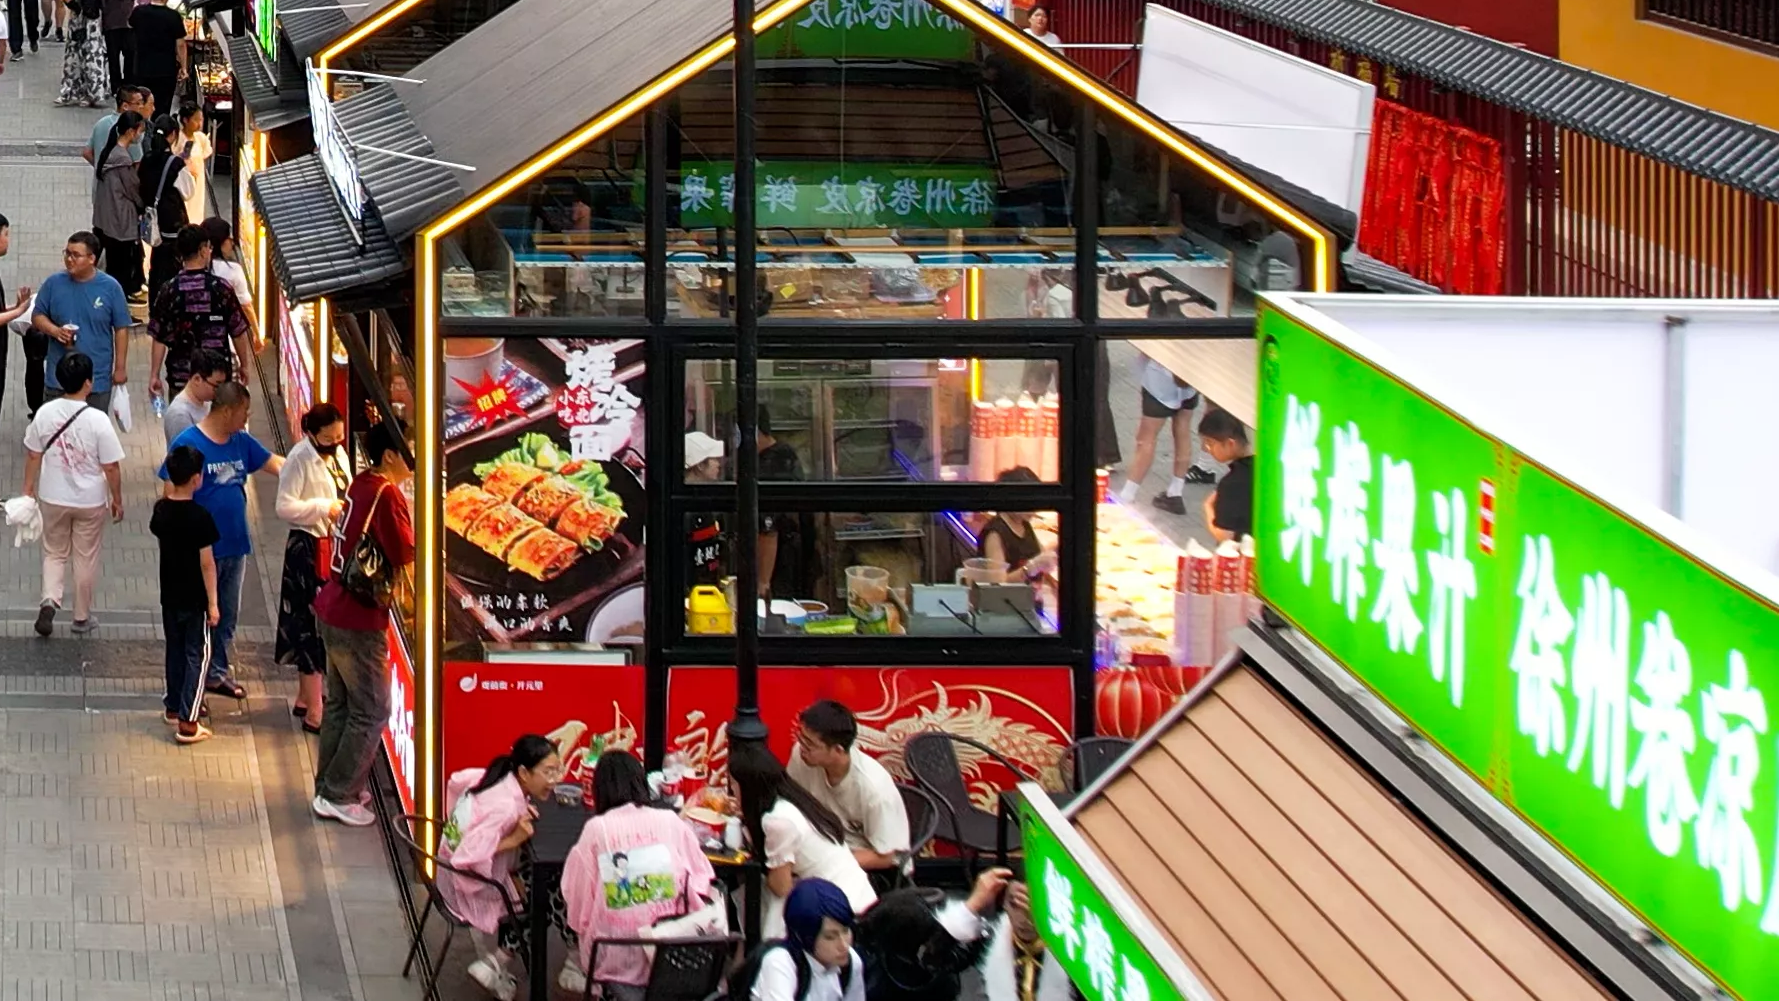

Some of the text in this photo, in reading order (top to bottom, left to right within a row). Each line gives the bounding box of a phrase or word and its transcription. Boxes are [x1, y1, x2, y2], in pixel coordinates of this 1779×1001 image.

[1280, 393, 1477, 709] 鲜榨果汁
[1510, 532, 1779, 936] 徐州卷凉
